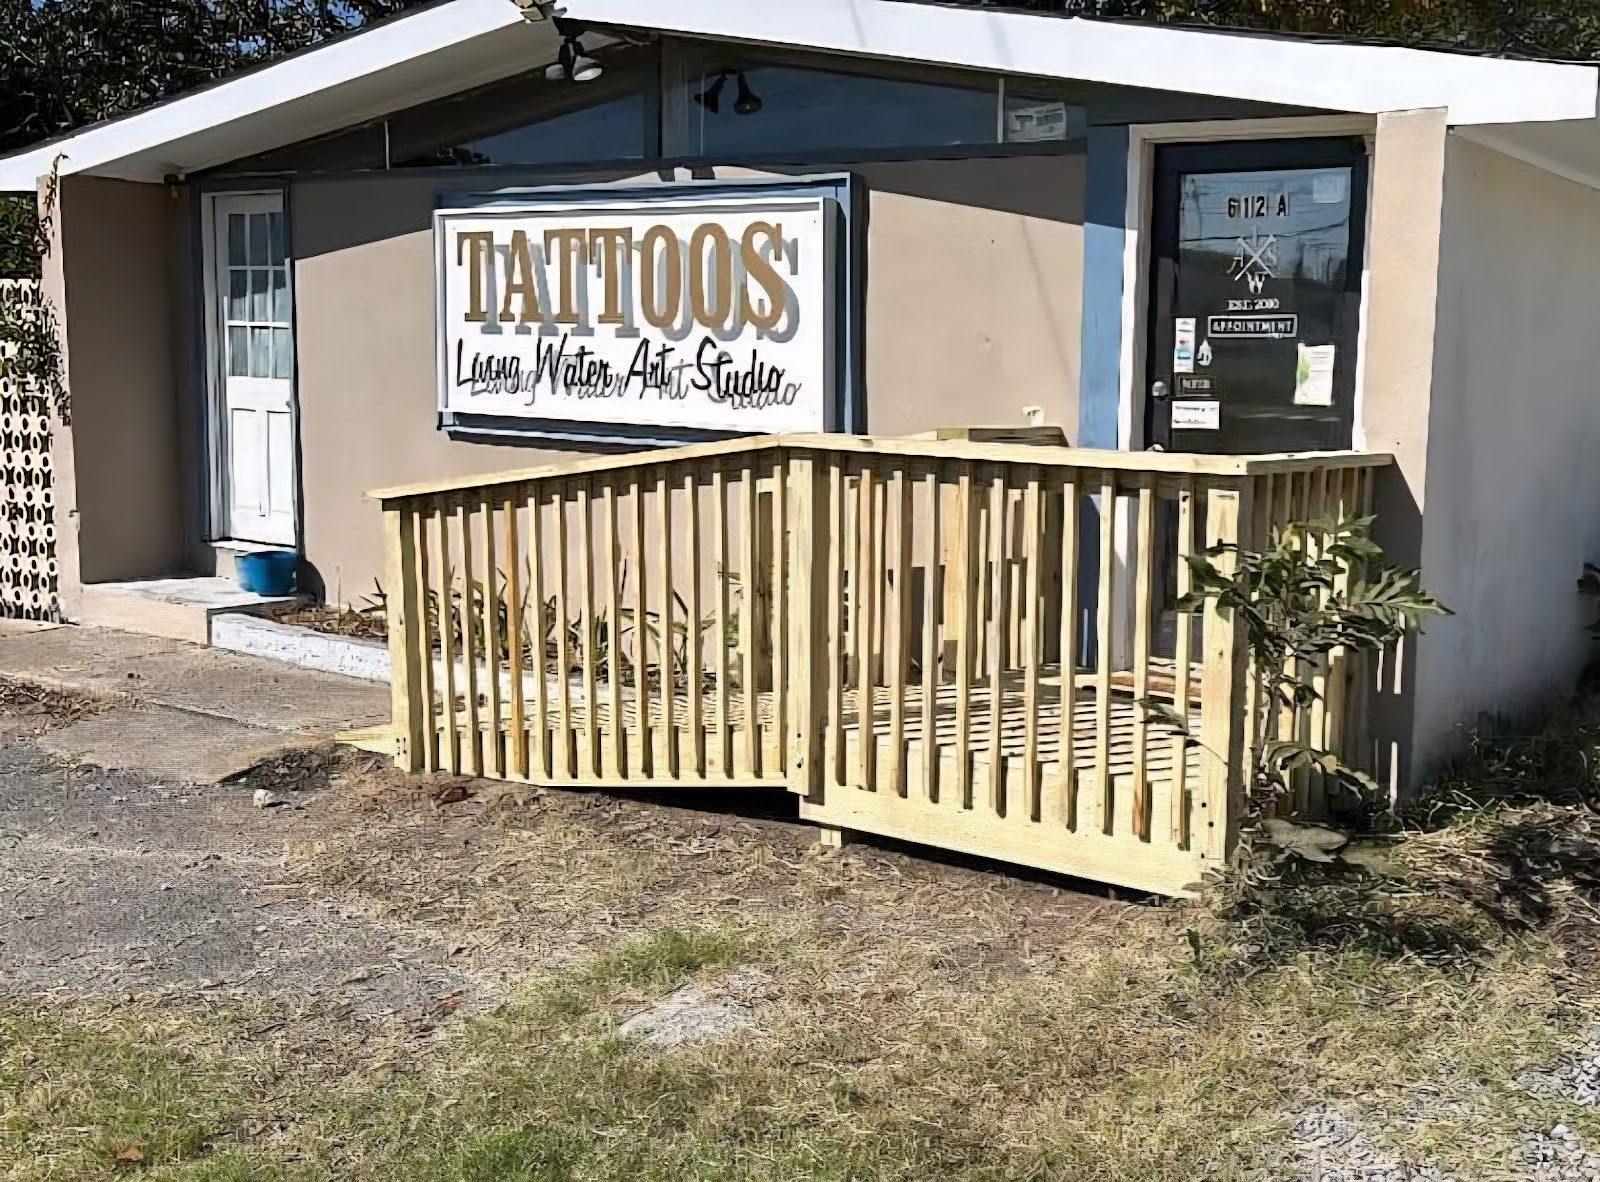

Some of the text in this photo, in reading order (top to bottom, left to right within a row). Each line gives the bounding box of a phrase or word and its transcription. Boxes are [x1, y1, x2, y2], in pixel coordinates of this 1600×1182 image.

[1277, 194, 1288, 217] A
[457, 221, 796, 338] TATTOOS
[535, 332, 615, 396] Water
[622, 337, 679, 399] Art
[690, 336, 790, 402] Studio
